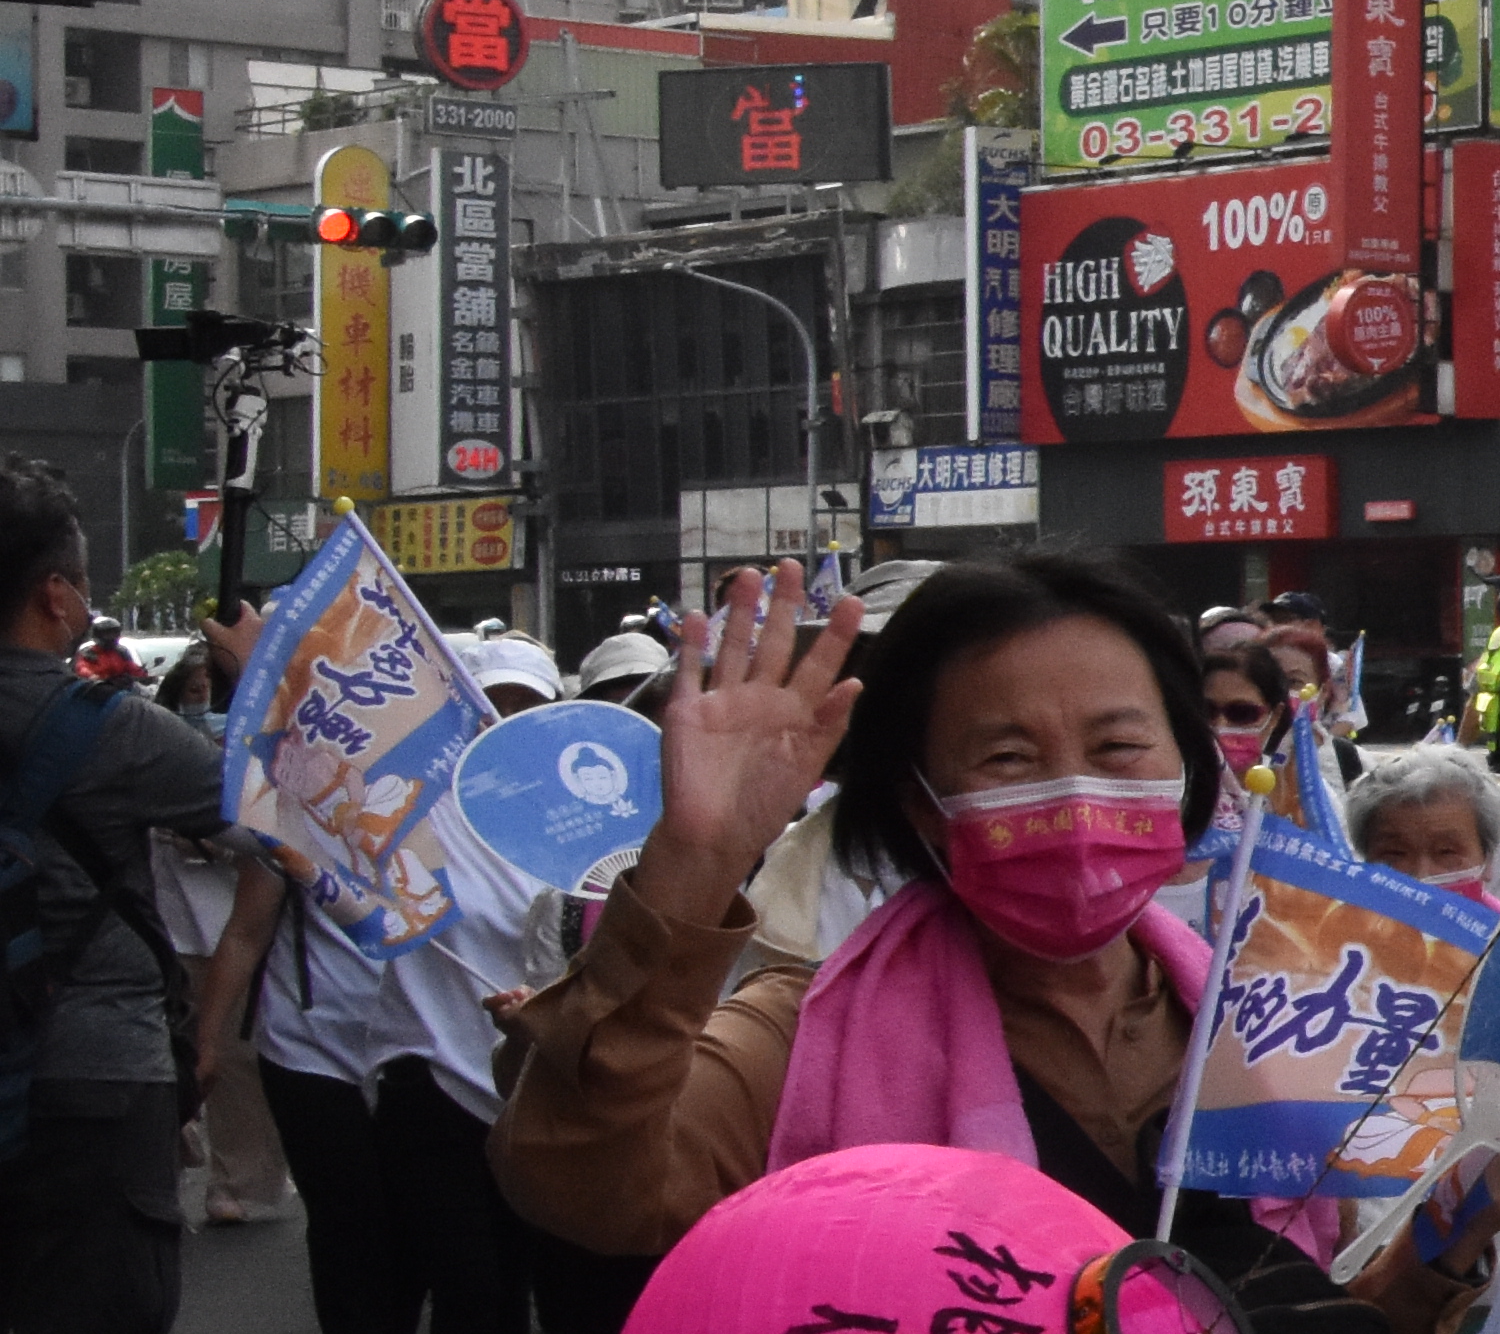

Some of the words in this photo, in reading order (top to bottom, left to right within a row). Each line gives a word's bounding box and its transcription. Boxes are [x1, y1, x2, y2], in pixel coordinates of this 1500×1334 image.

[435, 103, 516, 130] 331-2000
[452, 155, 498, 327] 北區當舖
[1202, 190, 1304, 250] 100%
[1043, 257, 1120, 303] HIGH
[1043, 307, 1183, 358] QUALITY
[1357, 306, 1398, 323] 100%
[455, 446, 499, 471] 24H
[918, 450, 1038, 489] 大明汽車修理廠
[1182, 462, 1306, 516] 孫東寶
